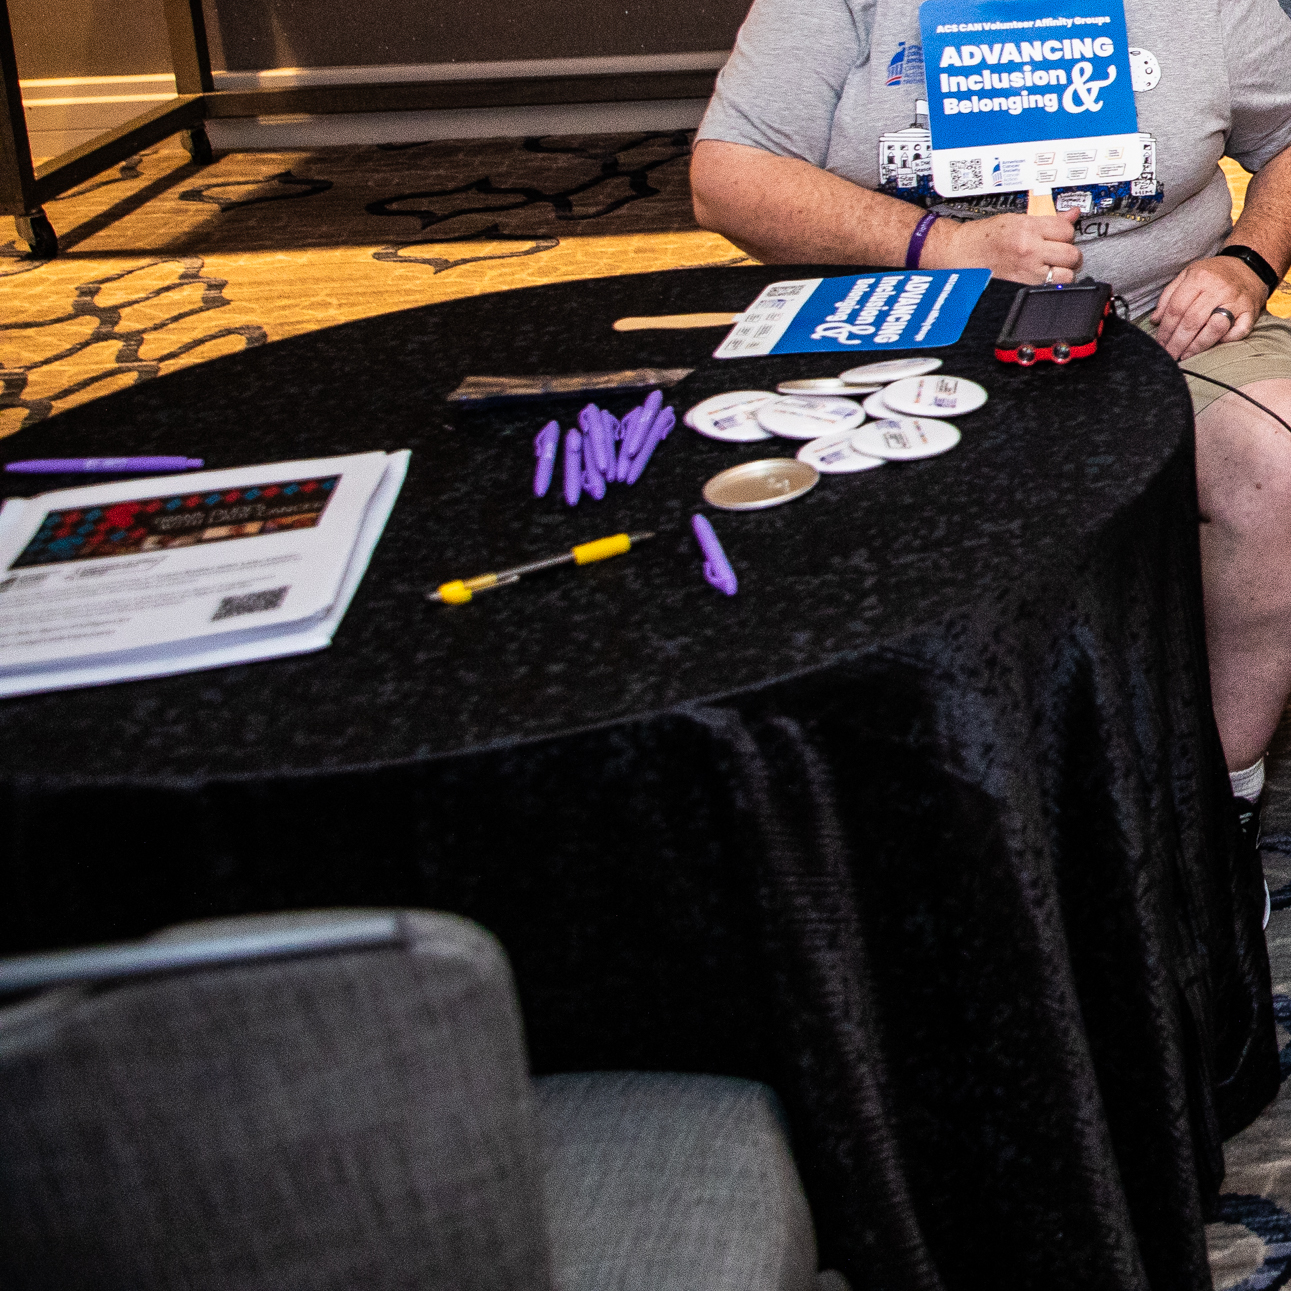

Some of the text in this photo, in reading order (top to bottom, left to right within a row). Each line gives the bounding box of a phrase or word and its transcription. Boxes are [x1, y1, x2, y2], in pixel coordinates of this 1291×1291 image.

[936, 16, 1111, 34] ACS CAN Volunteer Affinity Groups
[940, 37, 1114, 68] ADVANCING
[940, 61, 1116, 114] Inclusion &
[943, 91, 1058, 115] Belonging
[825, 278, 876, 322] Belonging
[853, 275, 905, 325] Inclusion
[874, 275, 933, 344] ADVANCING
